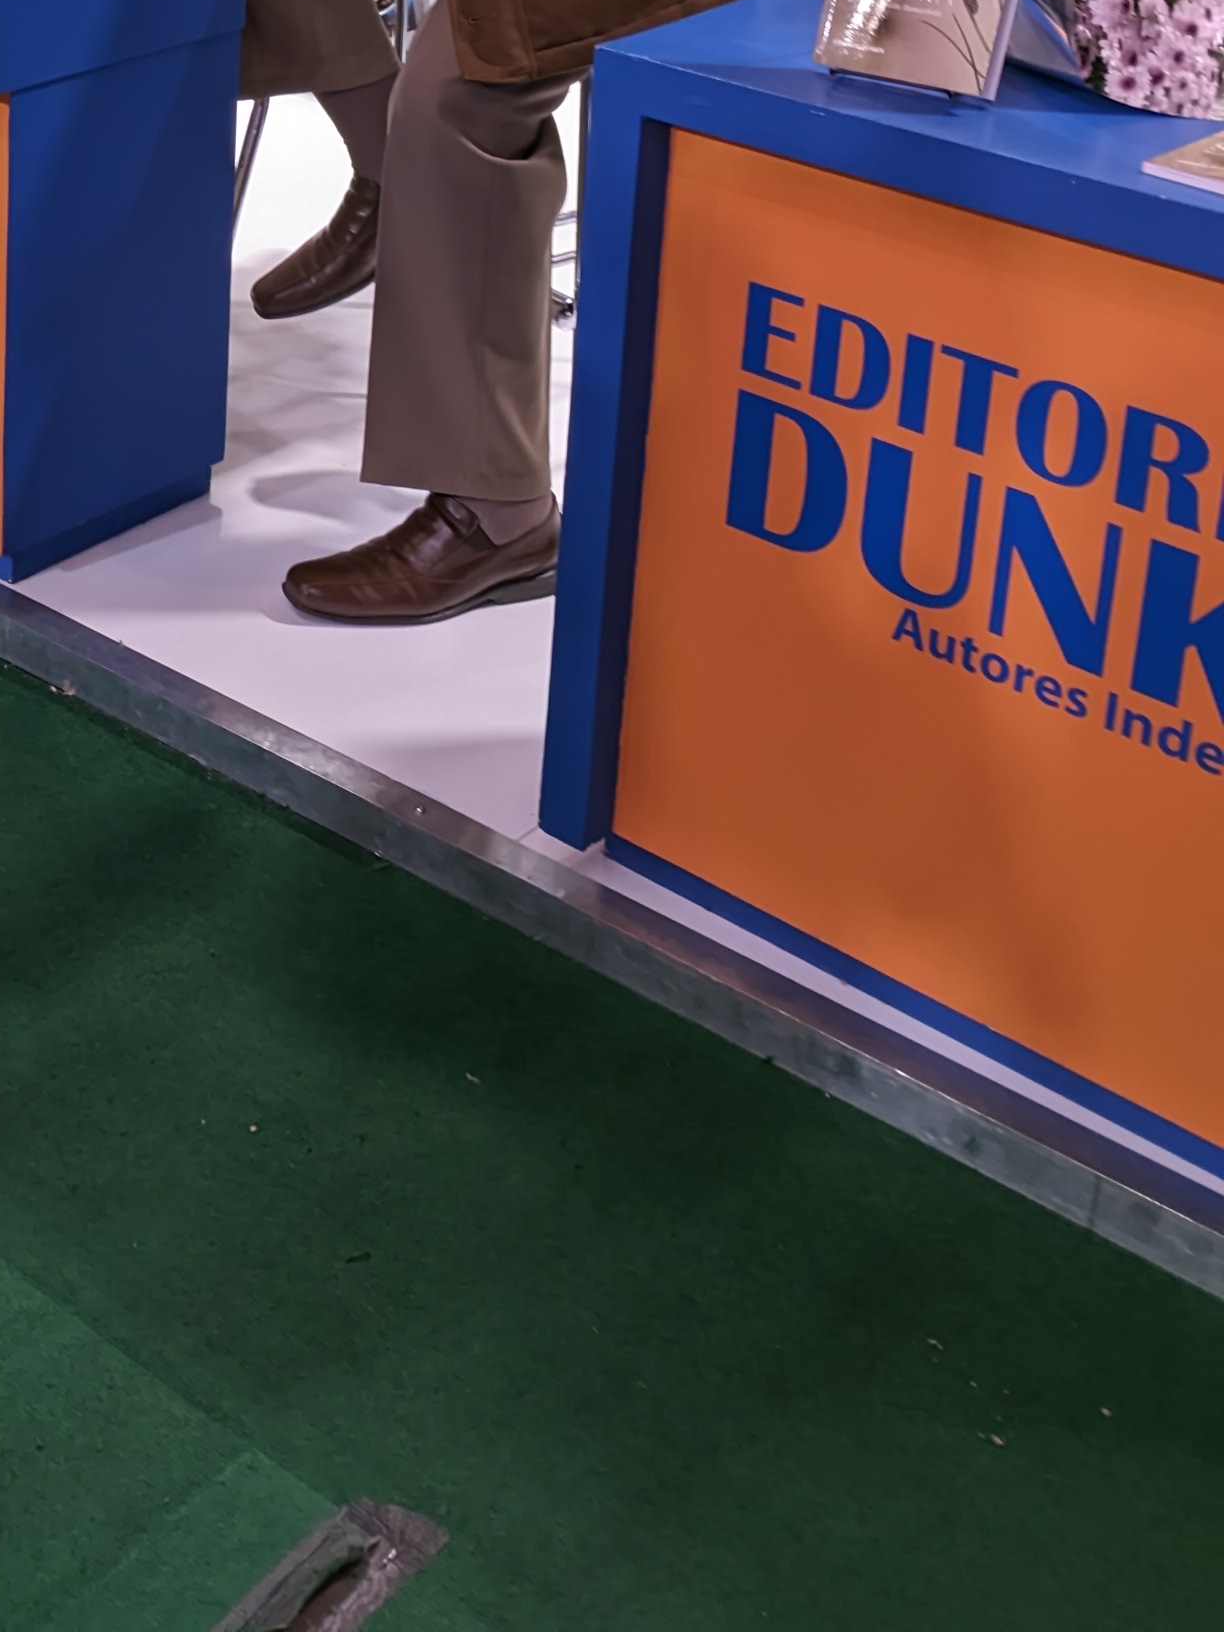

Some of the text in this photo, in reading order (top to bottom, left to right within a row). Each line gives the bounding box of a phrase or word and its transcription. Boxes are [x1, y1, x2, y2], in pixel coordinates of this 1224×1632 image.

[726, 388, 1224, 727] DUNK
[890, 607, 1224, 776] Autores Inde
